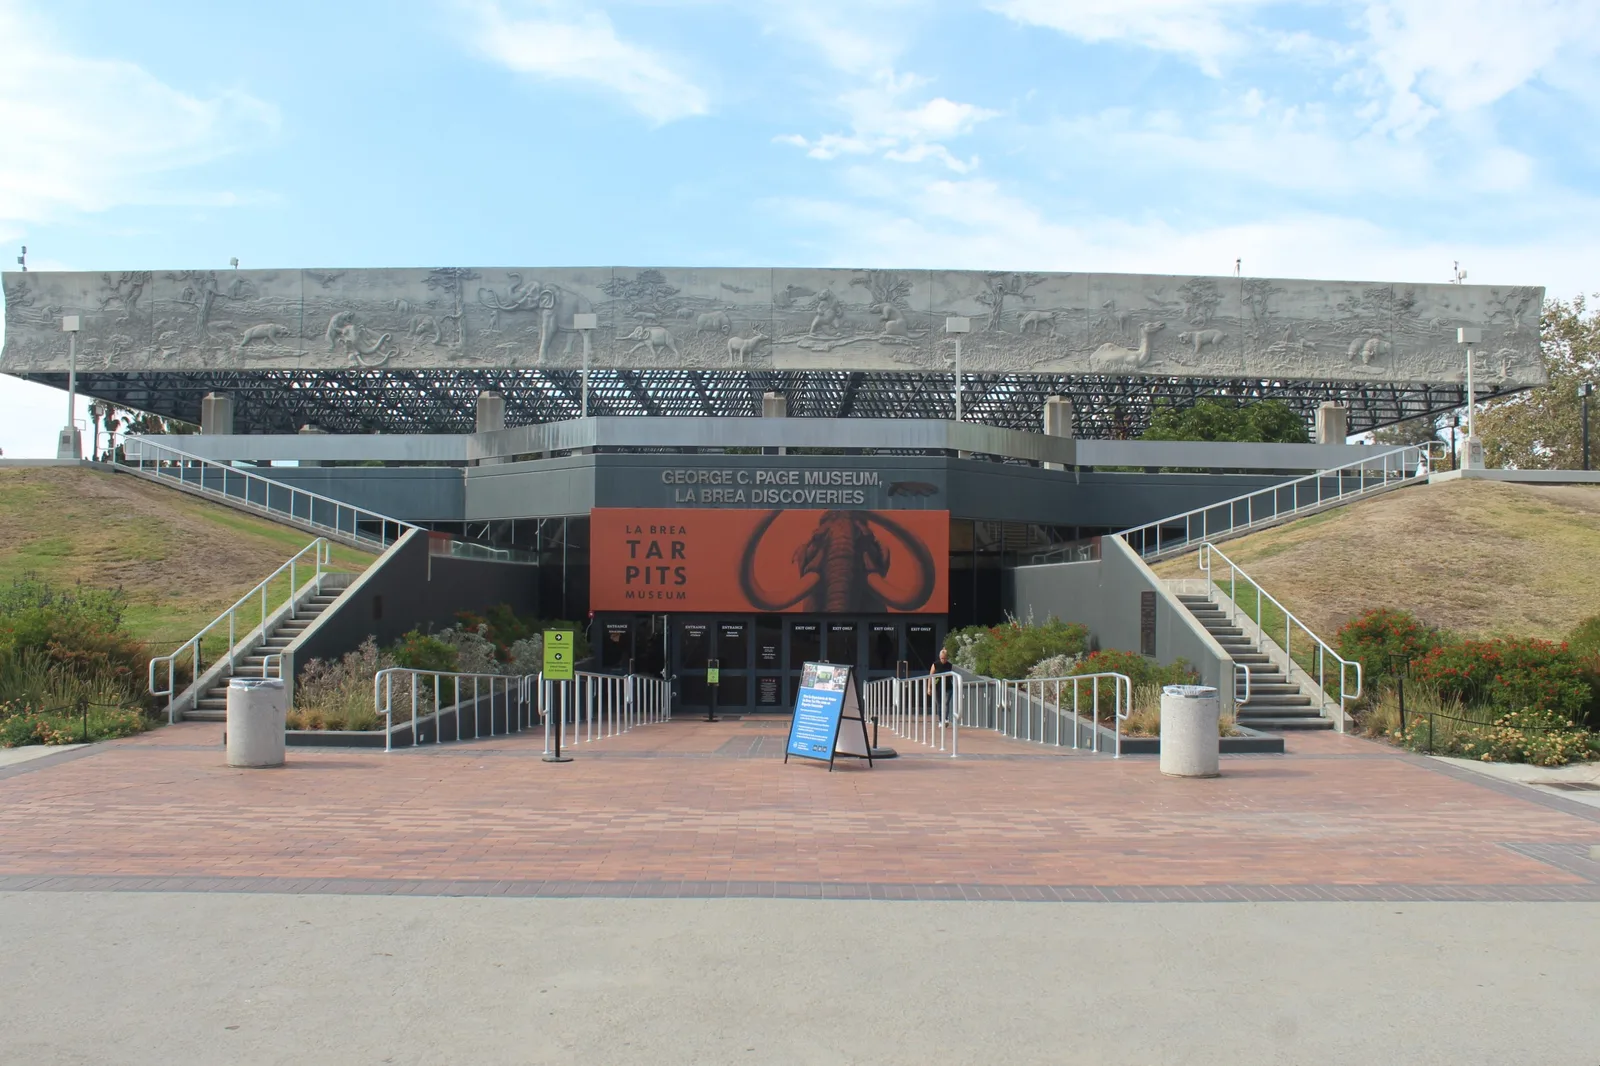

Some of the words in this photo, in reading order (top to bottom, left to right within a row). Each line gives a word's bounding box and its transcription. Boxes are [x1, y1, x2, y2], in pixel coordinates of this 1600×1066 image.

[661, 469, 733, 484] GEORGE
[736, 470, 753, 485] C.
[756, 470, 800, 485] PAGE
[675, 488, 697, 502] LA
[701, 488, 746, 503] BREA
[751, 489, 865, 504] DISCOVERIES
[626, 525, 642, 534] LA
[650, 525, 686, 535] BREA
[626, 540, 686, 560] TAR
[625, 565, 687, 586] PITS
[625, 590, 686, 600] MUSEUM
